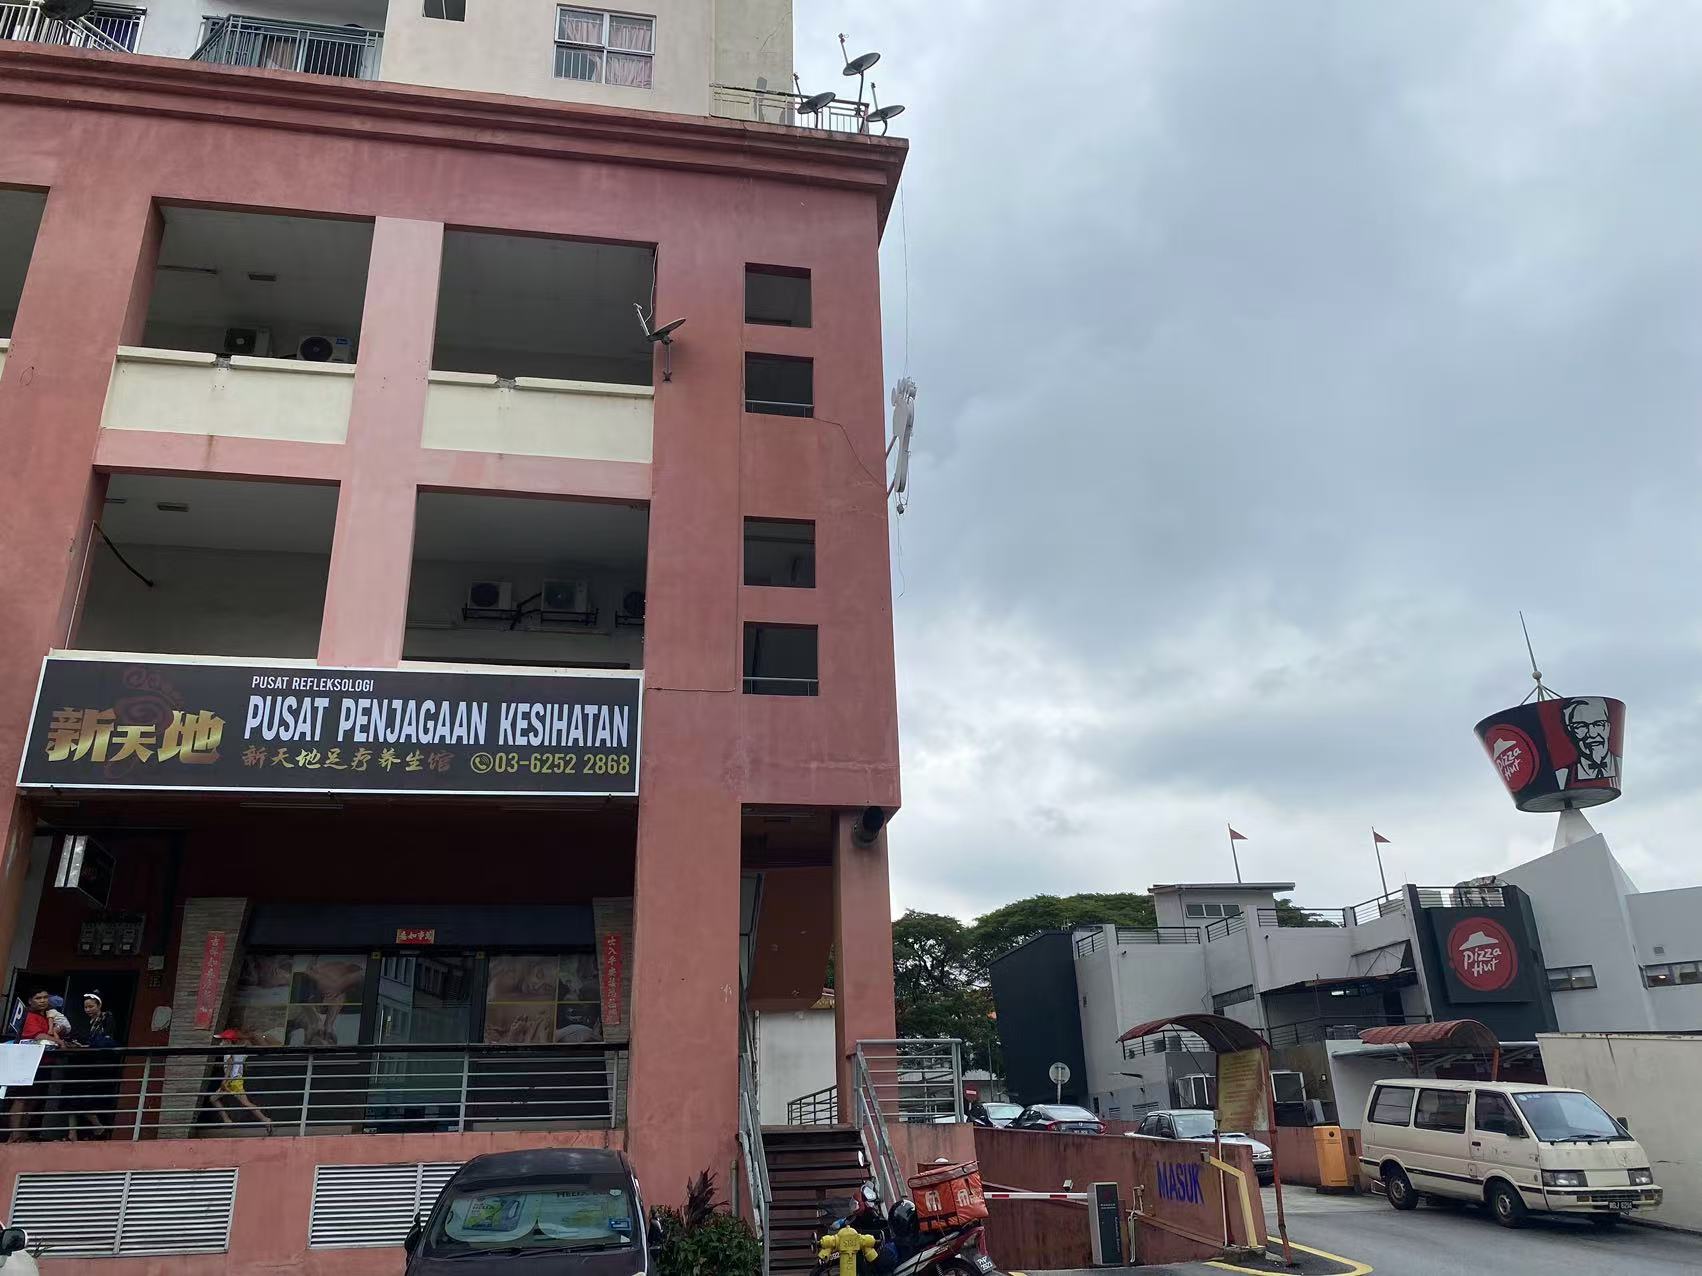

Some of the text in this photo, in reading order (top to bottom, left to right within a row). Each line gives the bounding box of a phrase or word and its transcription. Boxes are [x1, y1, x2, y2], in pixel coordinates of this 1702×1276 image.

[252, 676, 374, 692] PUSAT REFLEKSOLOGI
[243, 695, 629, 747] PUSAT PENJAGAAN KESIHATAN
[45, 707, 226, 764] 新天地
[495, 752, 630, 775] 03-6252 2868
[1504, 758, 1521, 781] Hut
[1472, 958, 1499, 977] Hut
[1156, 1160, 1205, 1205] MASUK
